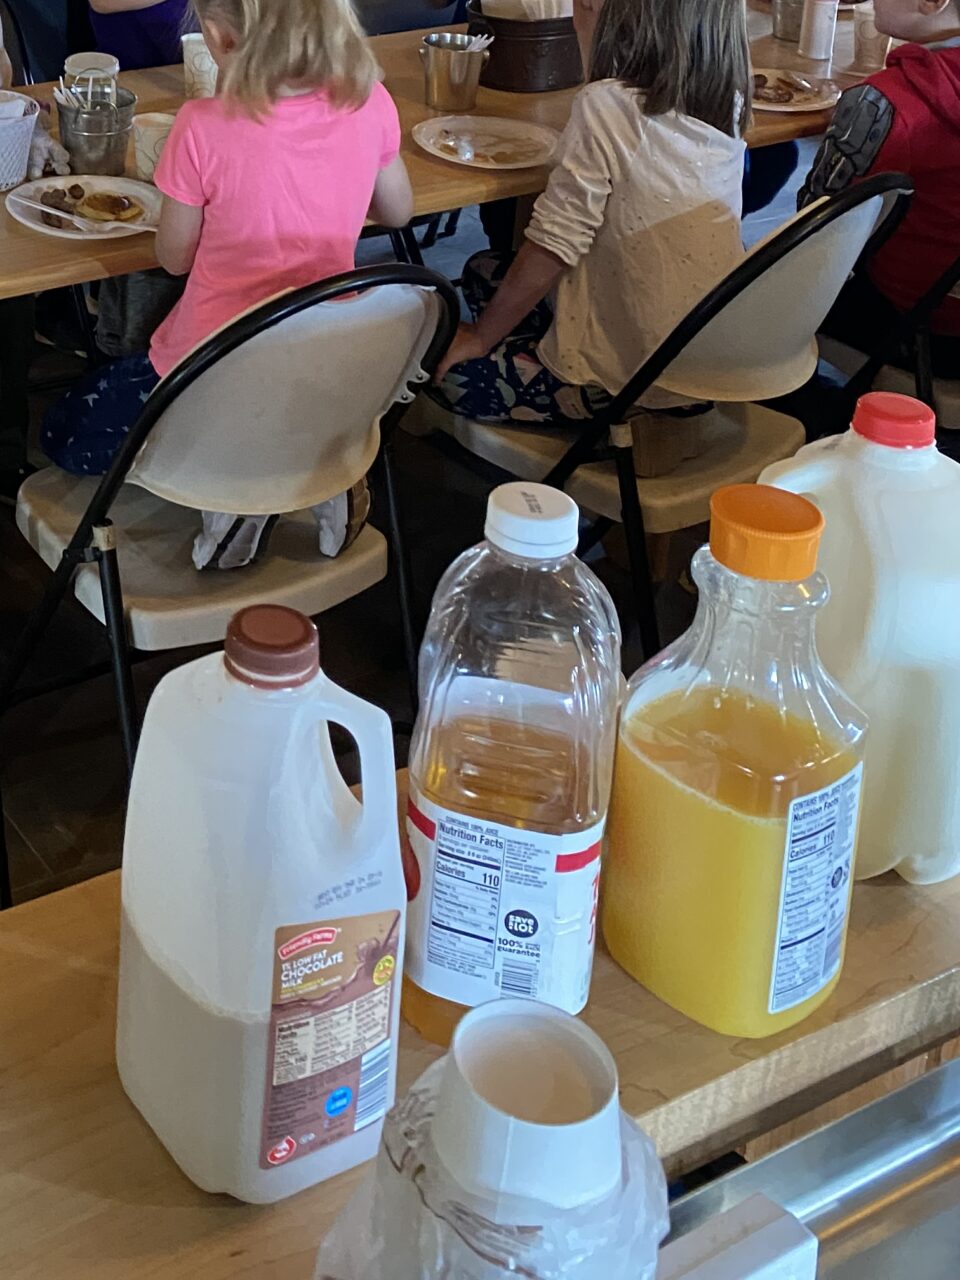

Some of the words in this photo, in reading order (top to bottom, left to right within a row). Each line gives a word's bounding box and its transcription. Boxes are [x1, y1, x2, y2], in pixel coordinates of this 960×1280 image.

[793, 806, 823, 822] Nutrition
[823, 797, 839, 811] Facts
[440, 822, 477, 843] Nutrition
[480, 834, 504, 850] Facts
[790, 844, 817, 859] Calories
[823, 829, 835, 845] 110
[436, 860, 466, 877] Calories
[483, 872, 500, 888] 110
[509, 914, 535, 925] save
[312, 931, 333, 941] Farms
[498, 937, 523, 949] 100%
[292, 956, 312, 969] LOW
[313, 949, 328, 960] FAT
[497, 945, 541, 958] guarantee
[281, 951, 344, 980] CHOCOLATE
[281, 977, 304, 988] MILK
